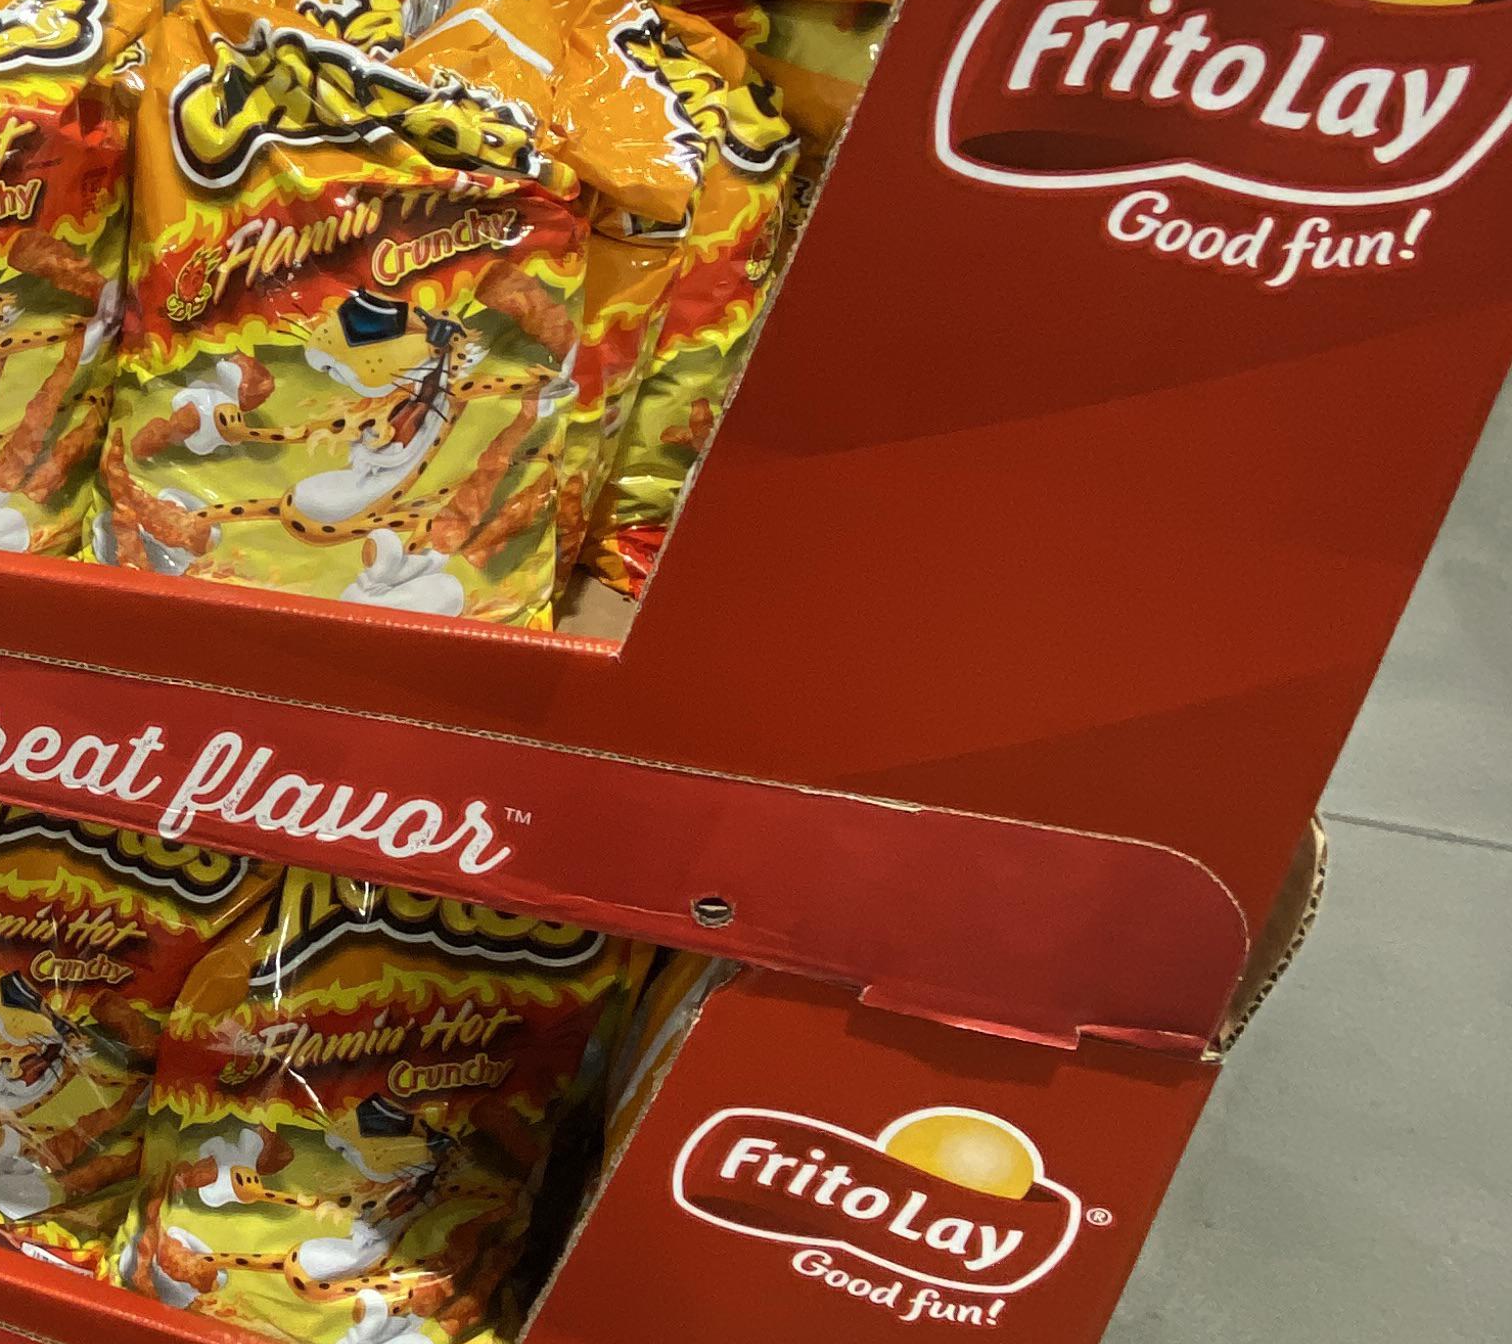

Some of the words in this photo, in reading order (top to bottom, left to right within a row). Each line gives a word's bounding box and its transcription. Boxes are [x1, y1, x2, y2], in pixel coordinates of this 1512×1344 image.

[371, 206, 520, 288] Crunchy
[1107, 188, 1269, 270] Good
[1266, 207, 1434, 288] fun!
[157, 730, 511, 875] flavor
[66, 905, 148, 952] Hot
[29, 949, 135, 984] Crunchy
[420, 999, 524, 1052] Hot
[387, 1052, 516, 1099] Crunchy
[789, 1247, 900, 1312] Good
[904, 1285, 1008, 1329] fun!
